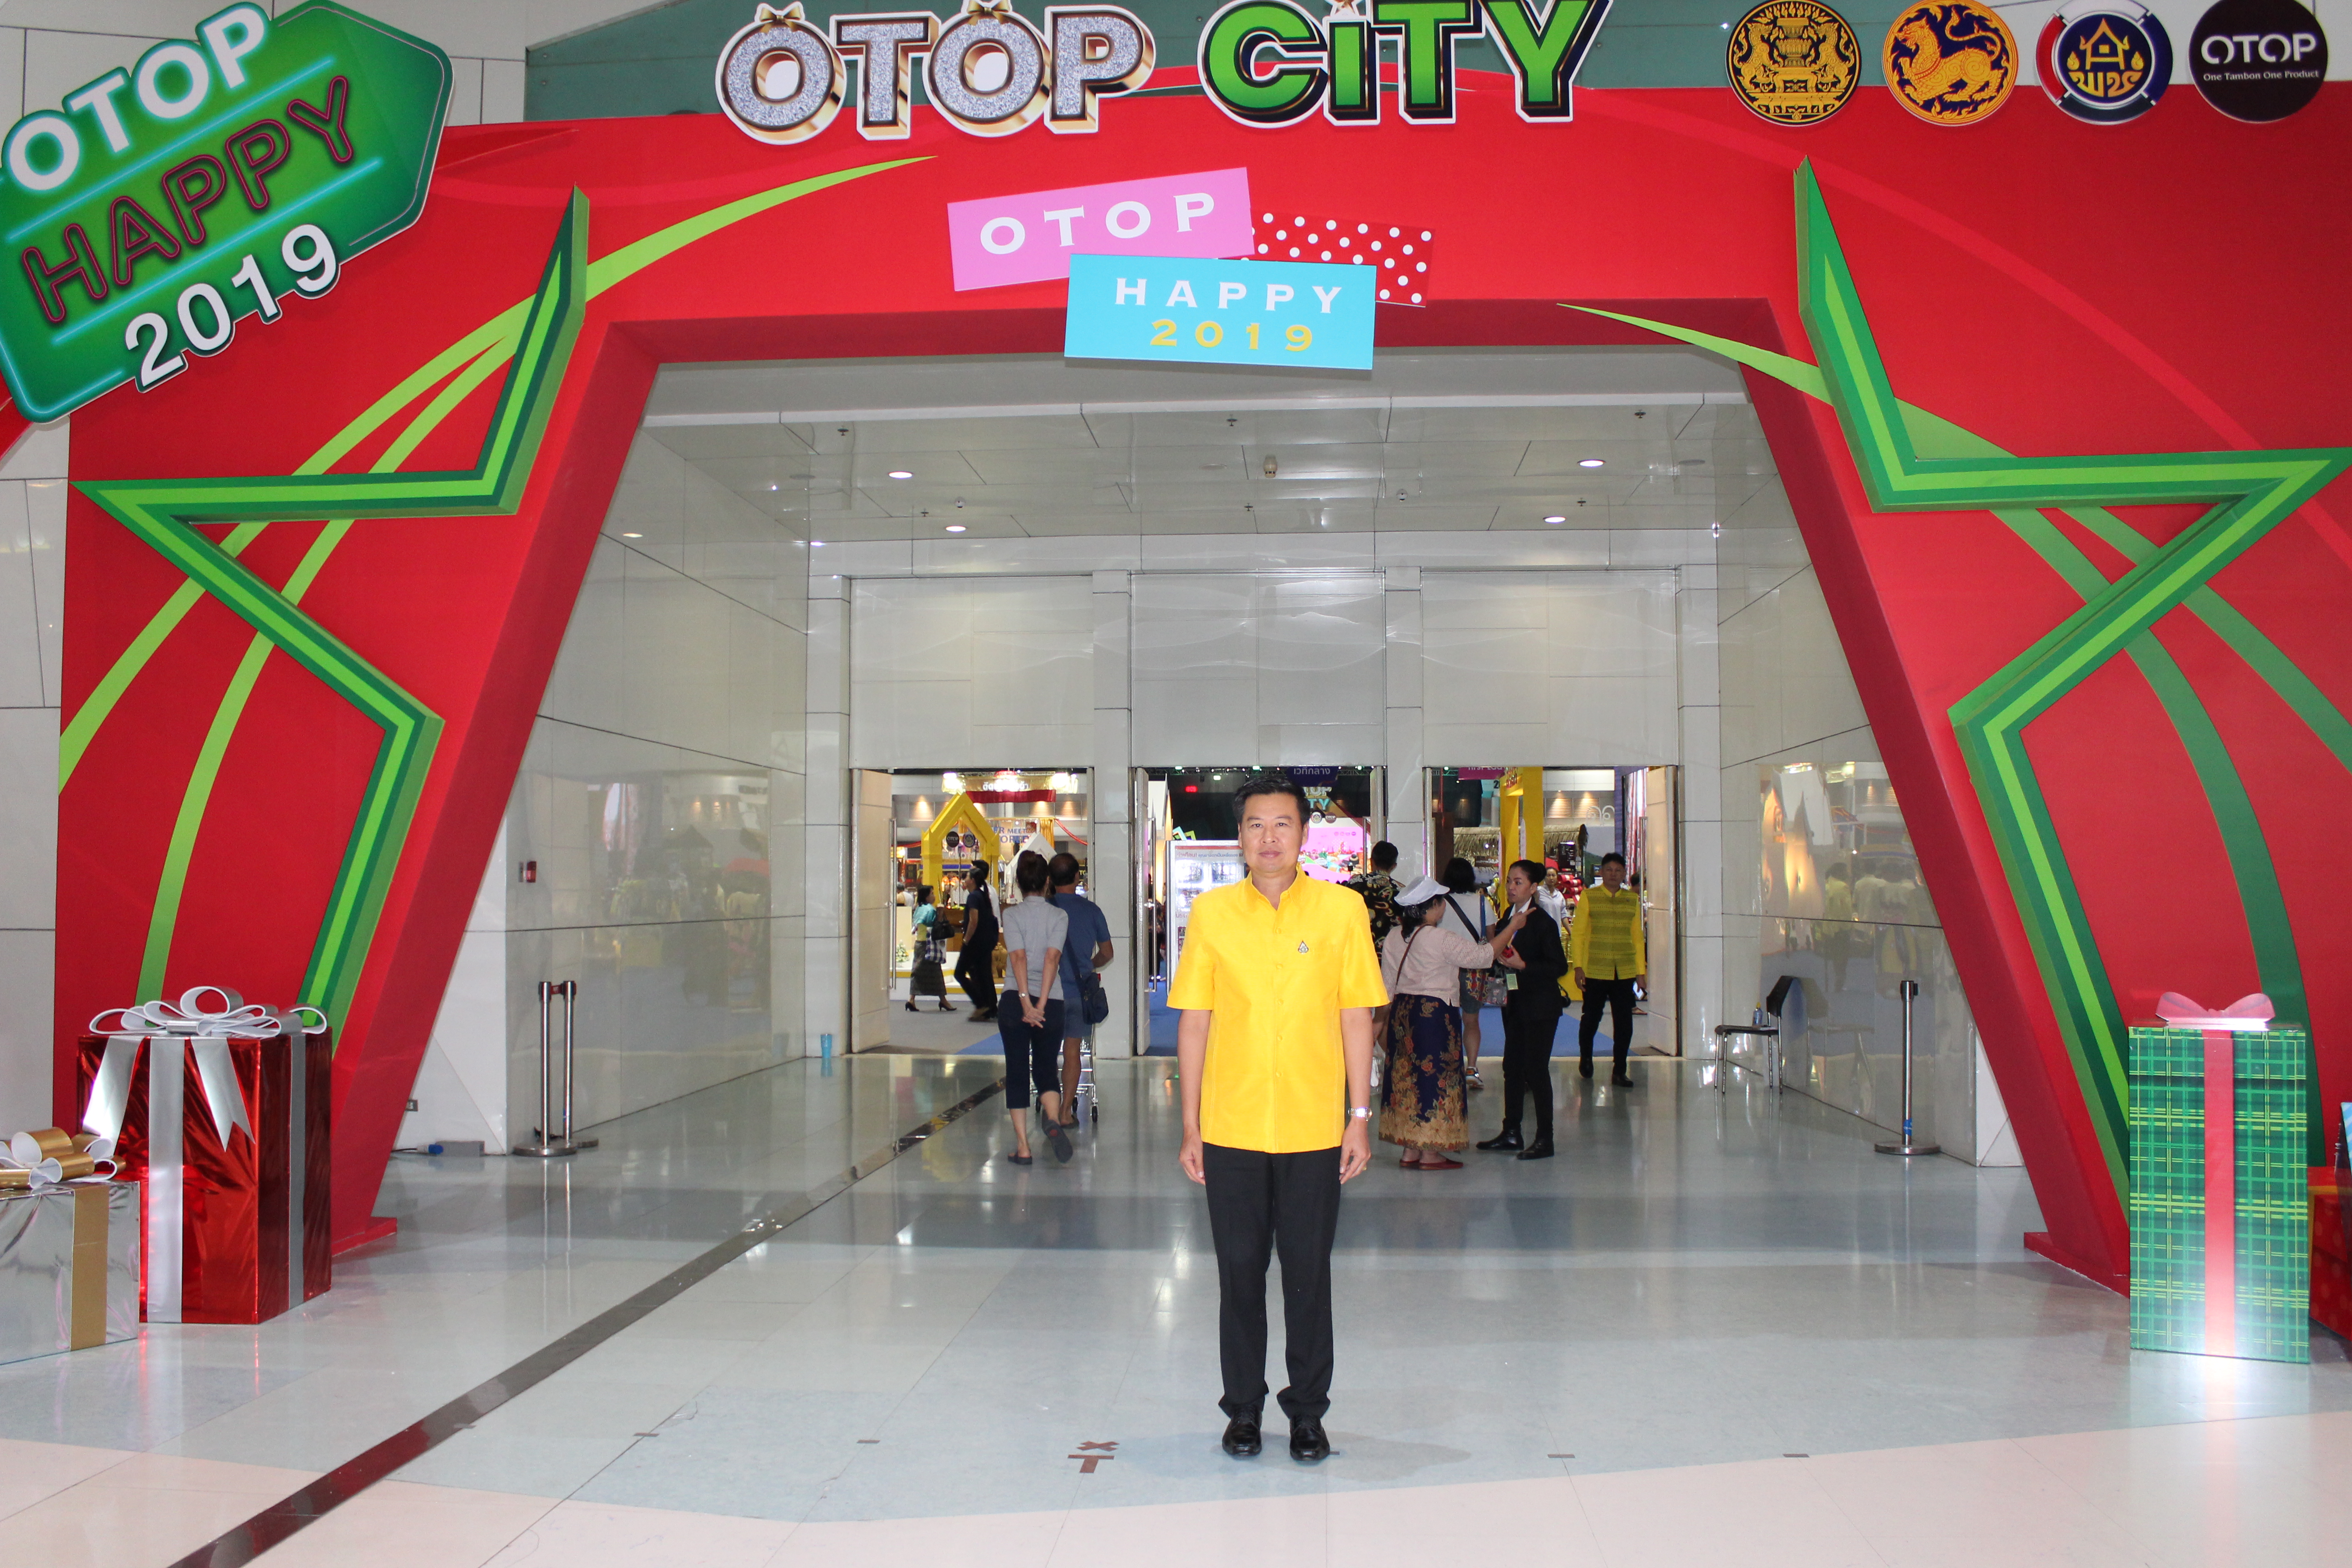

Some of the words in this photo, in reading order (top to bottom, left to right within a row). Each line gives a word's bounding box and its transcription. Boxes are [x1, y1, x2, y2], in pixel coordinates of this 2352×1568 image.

[718, 4, 1155, 143] OTOP
[2201, 33, 2316, 64] OTOP
[2224, 72, 2260, 80] Tambon
[2284, 70, 2318, 78] Product
[9, 8, 265, 191] OTOP
[22, 75, 354, 323] HAPPY
[980, 192, 1214, 255] OTOP
[124, 223, 337, 387] 2019
[1115, 278, 1342, 314] HAPPY
[1150, 318, 1313, 353] 2019
